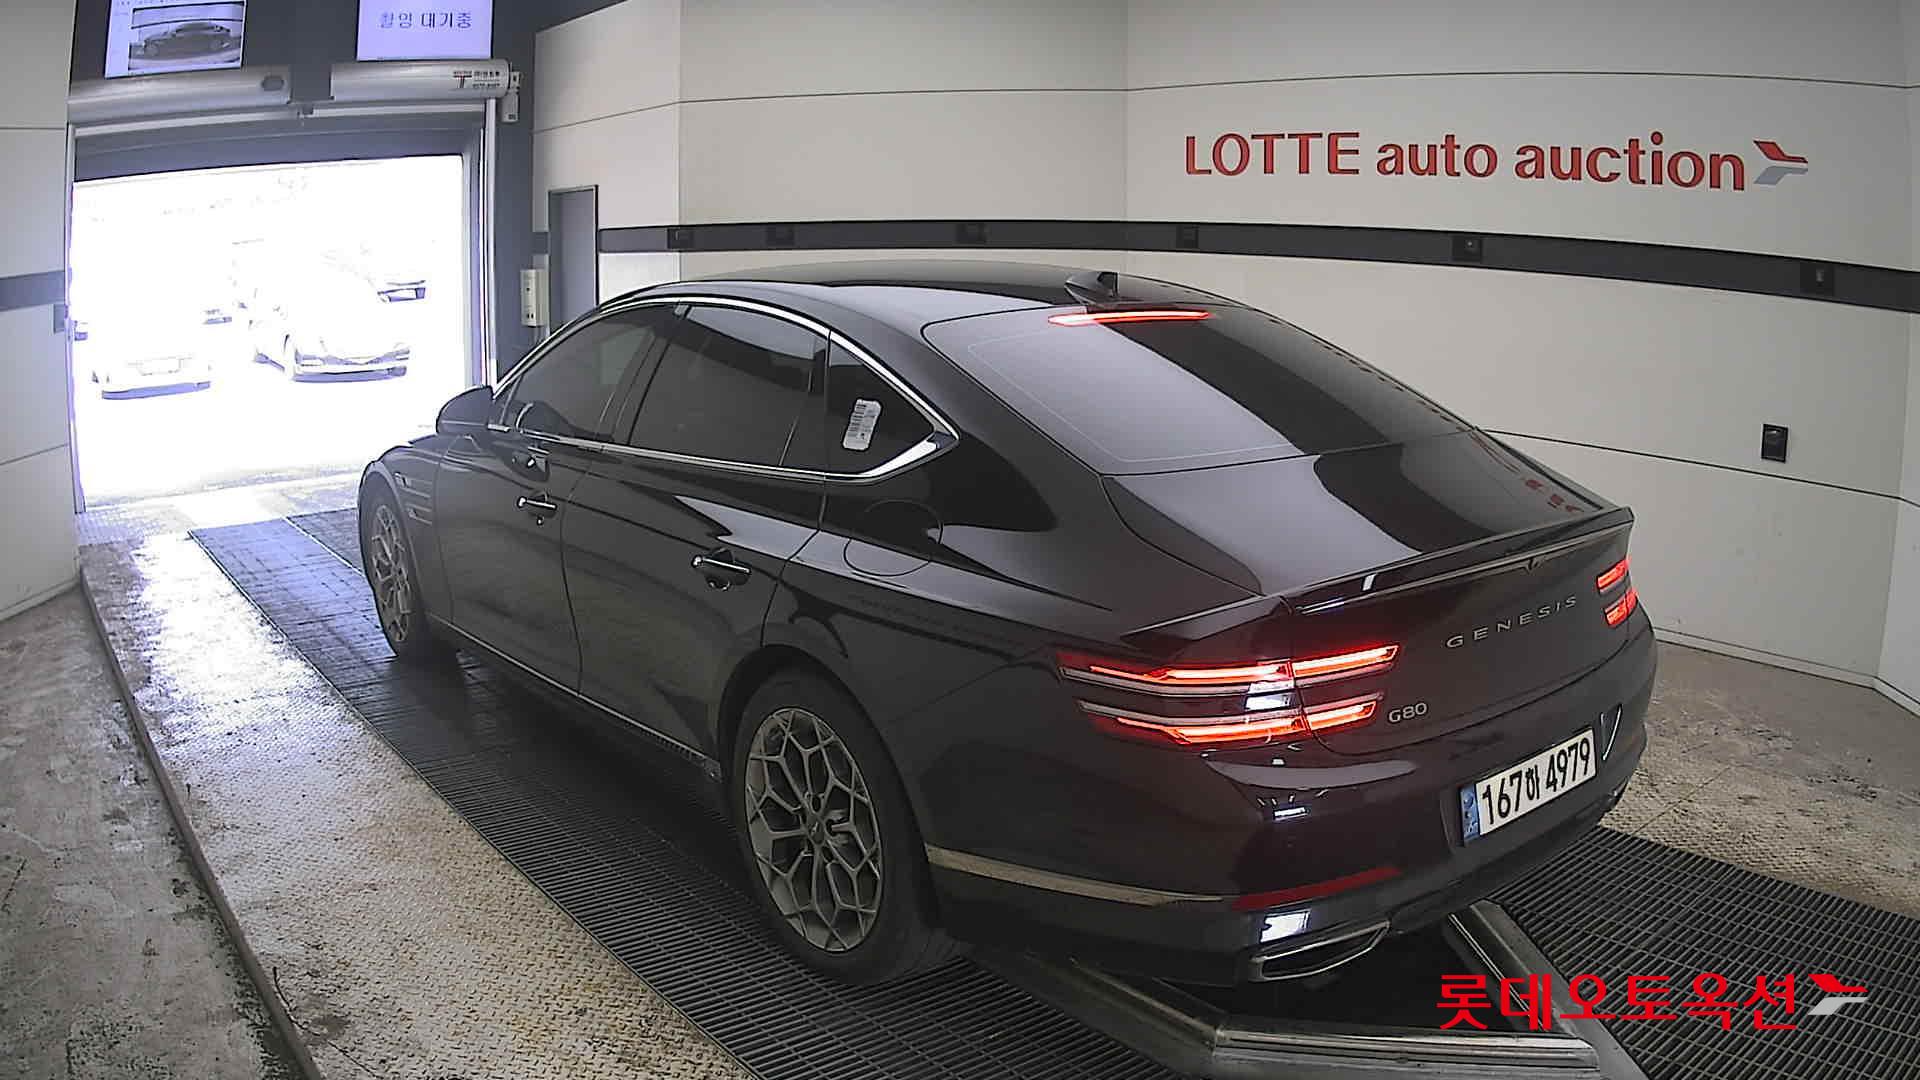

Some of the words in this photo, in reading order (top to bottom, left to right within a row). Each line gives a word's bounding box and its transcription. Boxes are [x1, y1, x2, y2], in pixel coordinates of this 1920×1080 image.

[421, 12, 471, 29] 대기중
[1185, 132, 1360, 177] LOTTE
[1377, 134, 1498, 178] auto
[1515, 131, 1745, 191] auction
[1446, 596, 1577, 648] GENESIS
[1388, 702, 1428, 723] G80
[1482, 764, 1540, 825] 167하
[1546, 737, 1591, 792] 4979
